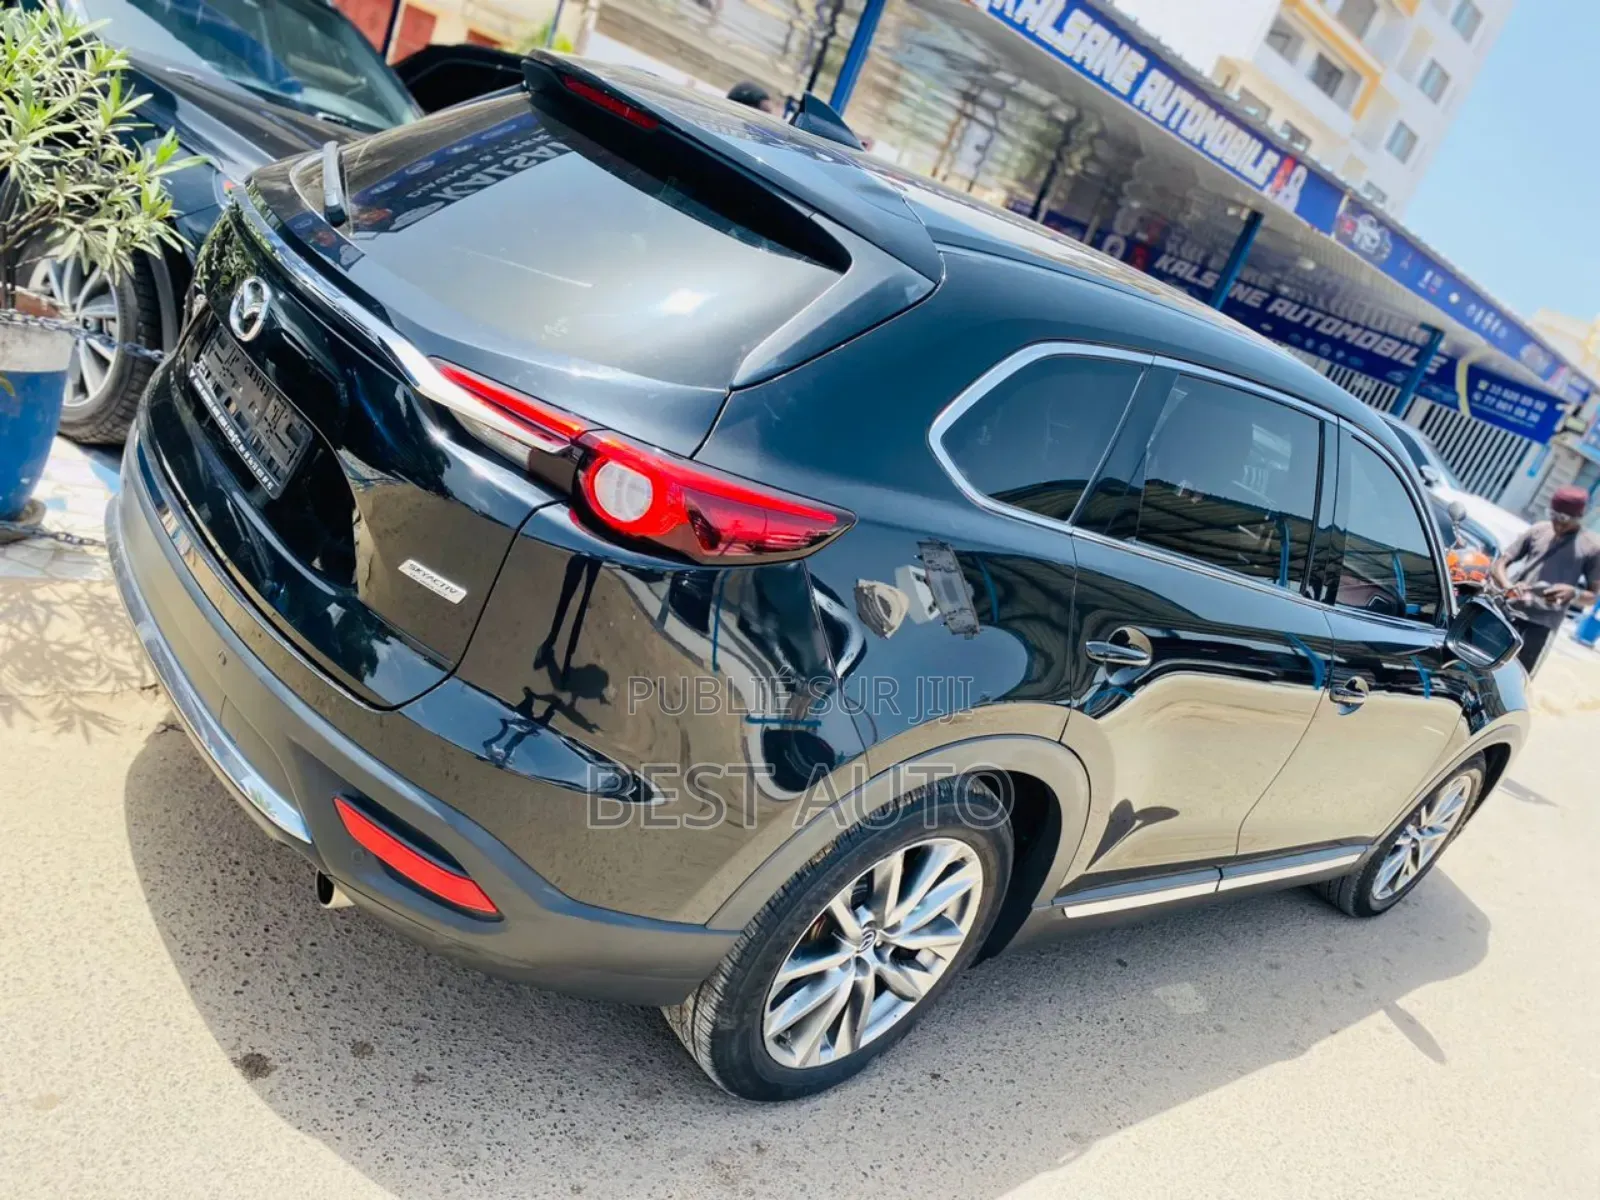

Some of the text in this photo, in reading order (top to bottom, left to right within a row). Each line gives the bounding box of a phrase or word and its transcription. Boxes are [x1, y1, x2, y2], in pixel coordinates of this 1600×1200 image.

[1132, 67, 1281, 186] AUTOMOBILE
[1154, 253, 1270, 308] KALSNE
[1266, 298, 1449, 376] AUTOMOBILE
[408, 562, 460, 595] SKYACTIV
